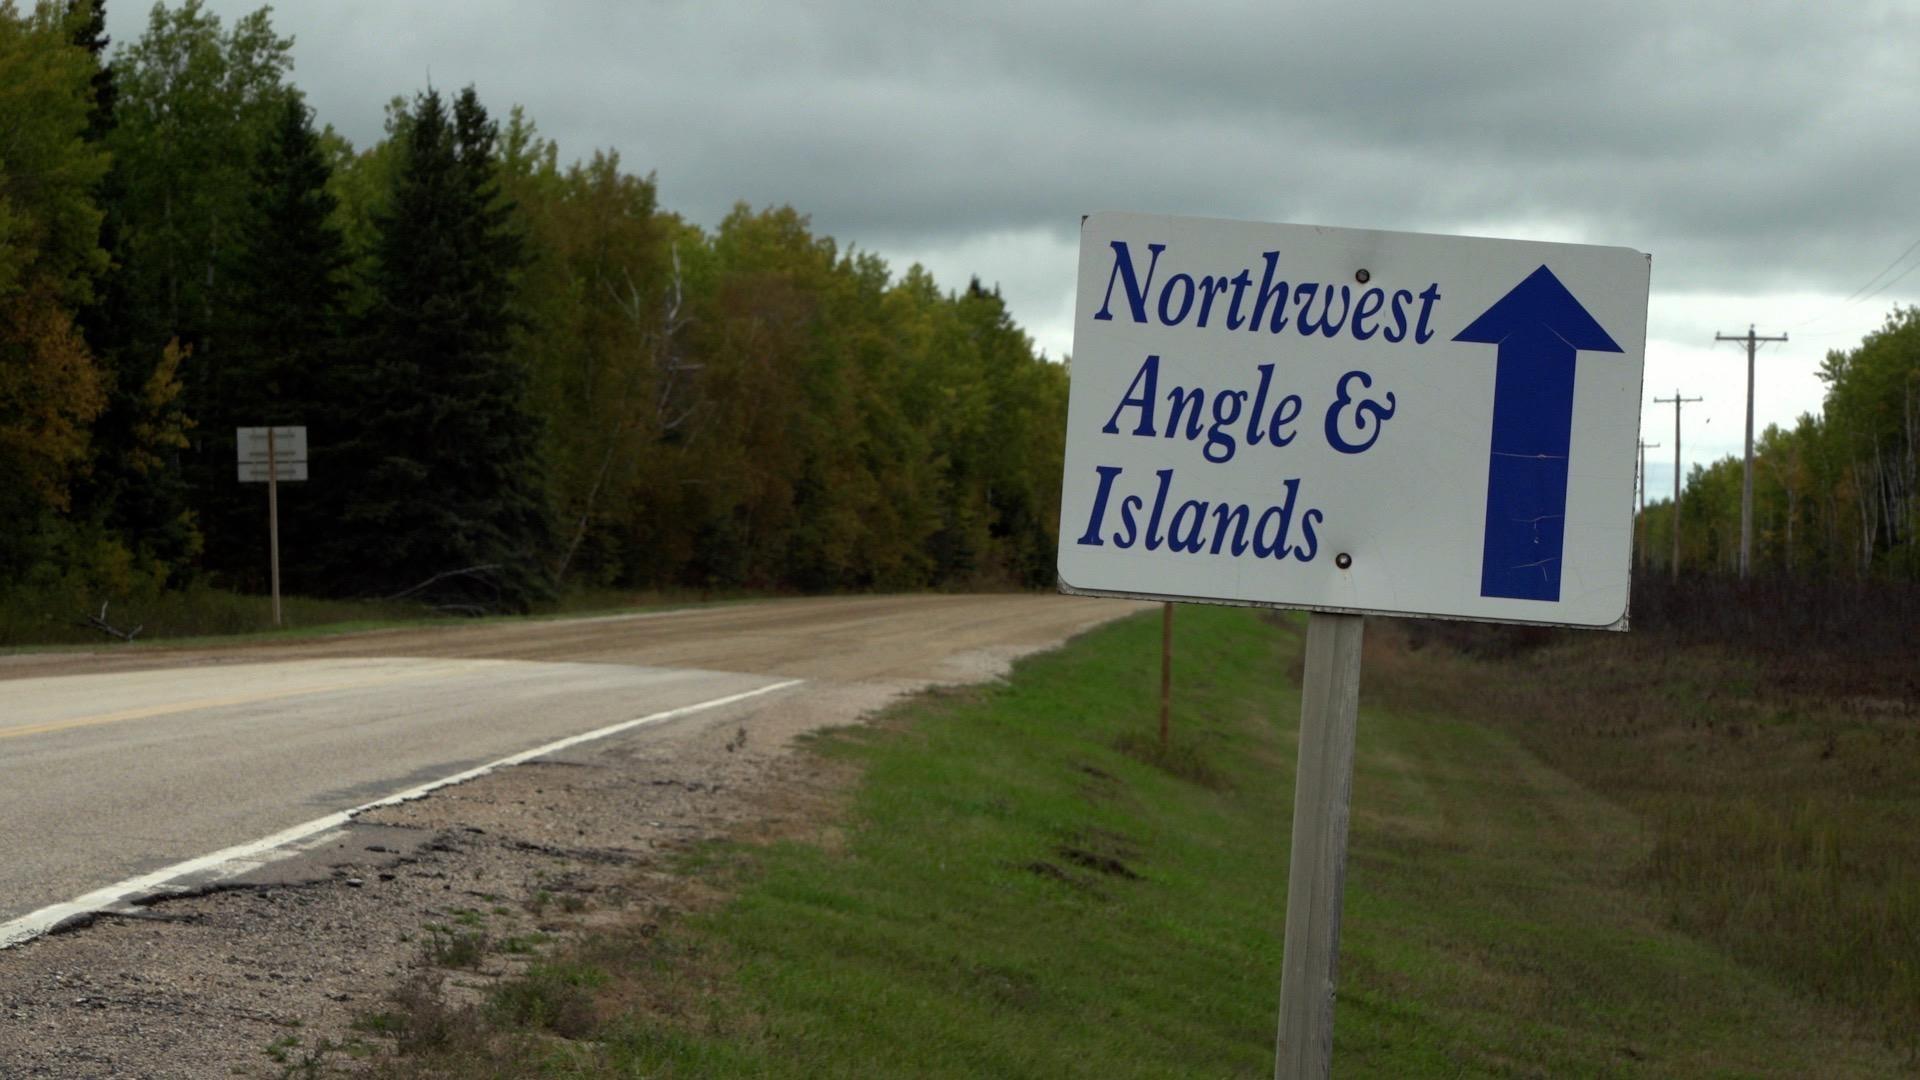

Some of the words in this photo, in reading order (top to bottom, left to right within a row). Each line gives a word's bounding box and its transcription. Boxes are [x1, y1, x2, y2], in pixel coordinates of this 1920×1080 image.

[1094, 240, 1441, 345] Northwest
[1102, 355, 1302, 464] Angle
[1324, 370, 1396, 454] &
[1077, 465, 1324, 562] Islands
